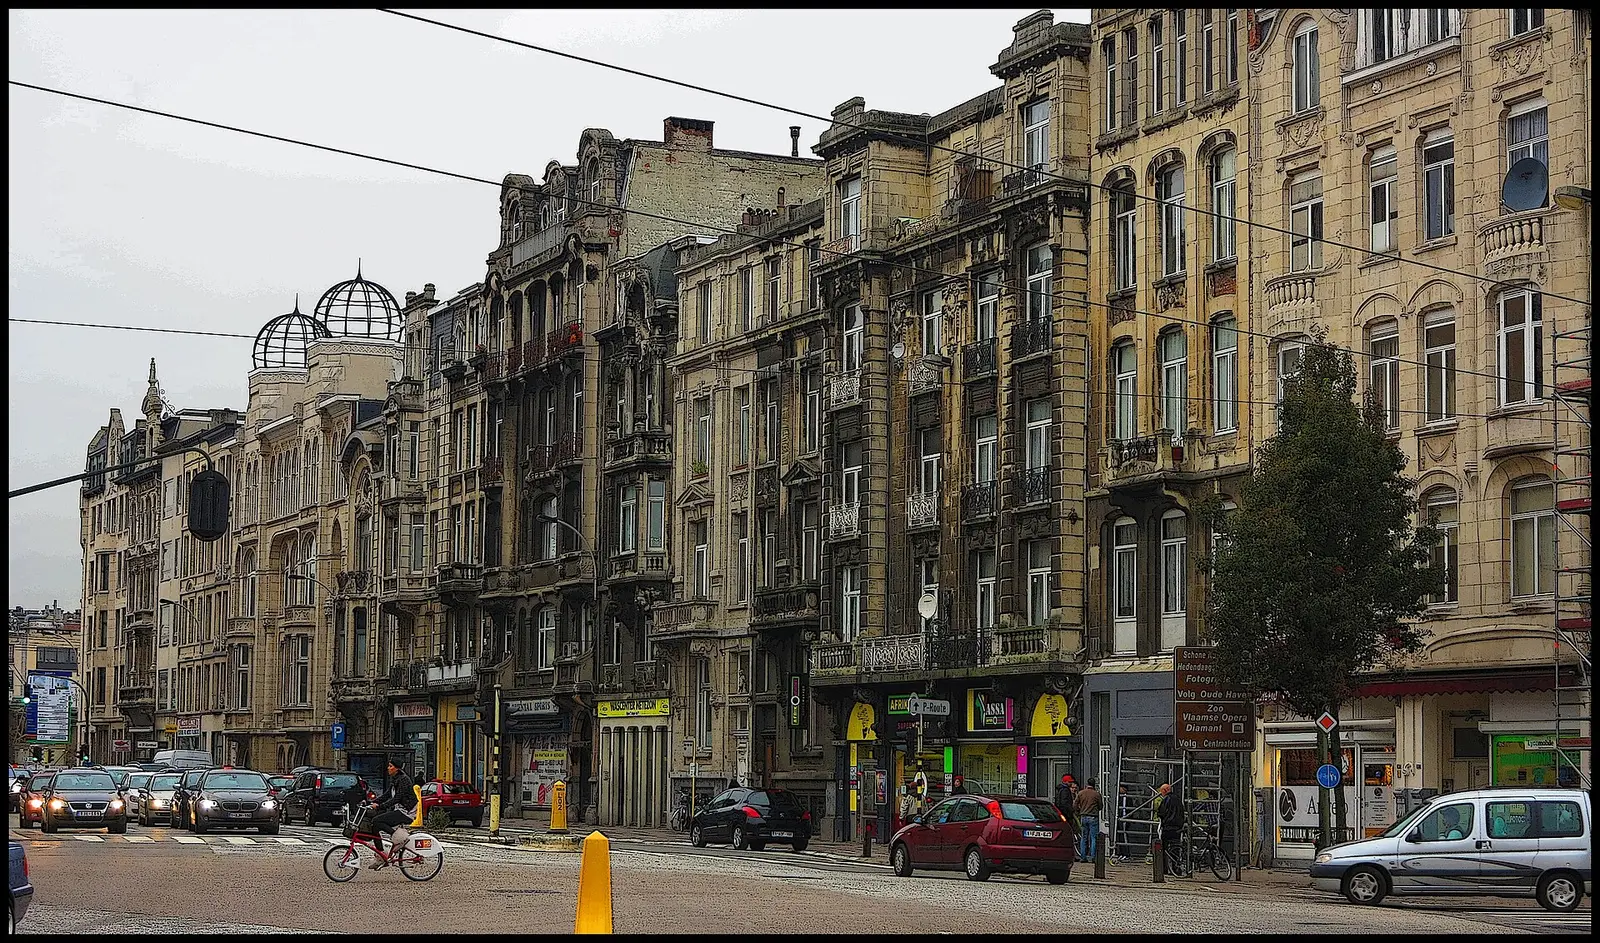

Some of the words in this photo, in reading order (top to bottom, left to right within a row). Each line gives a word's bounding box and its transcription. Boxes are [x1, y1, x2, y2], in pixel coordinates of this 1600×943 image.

[1183, 651, 1206, 659] Schone
[1177, 690, 1196, 700] Volg
[1200, 690, 1223, 698] Oude
[922, 701, 947, 713] P-Route
[1207, 704, 1224, 712] Zoo
[1182, 713, 1219, 721] Vlaamse
[1221, 713, 1248, 722] Opera
[334, 726, 342, 738] P
[1186, 723, 1223, 732] Diamant
[1178, 739, 1197, 749] Volg
[1203, 739, 1251, 748] Centraalstation
